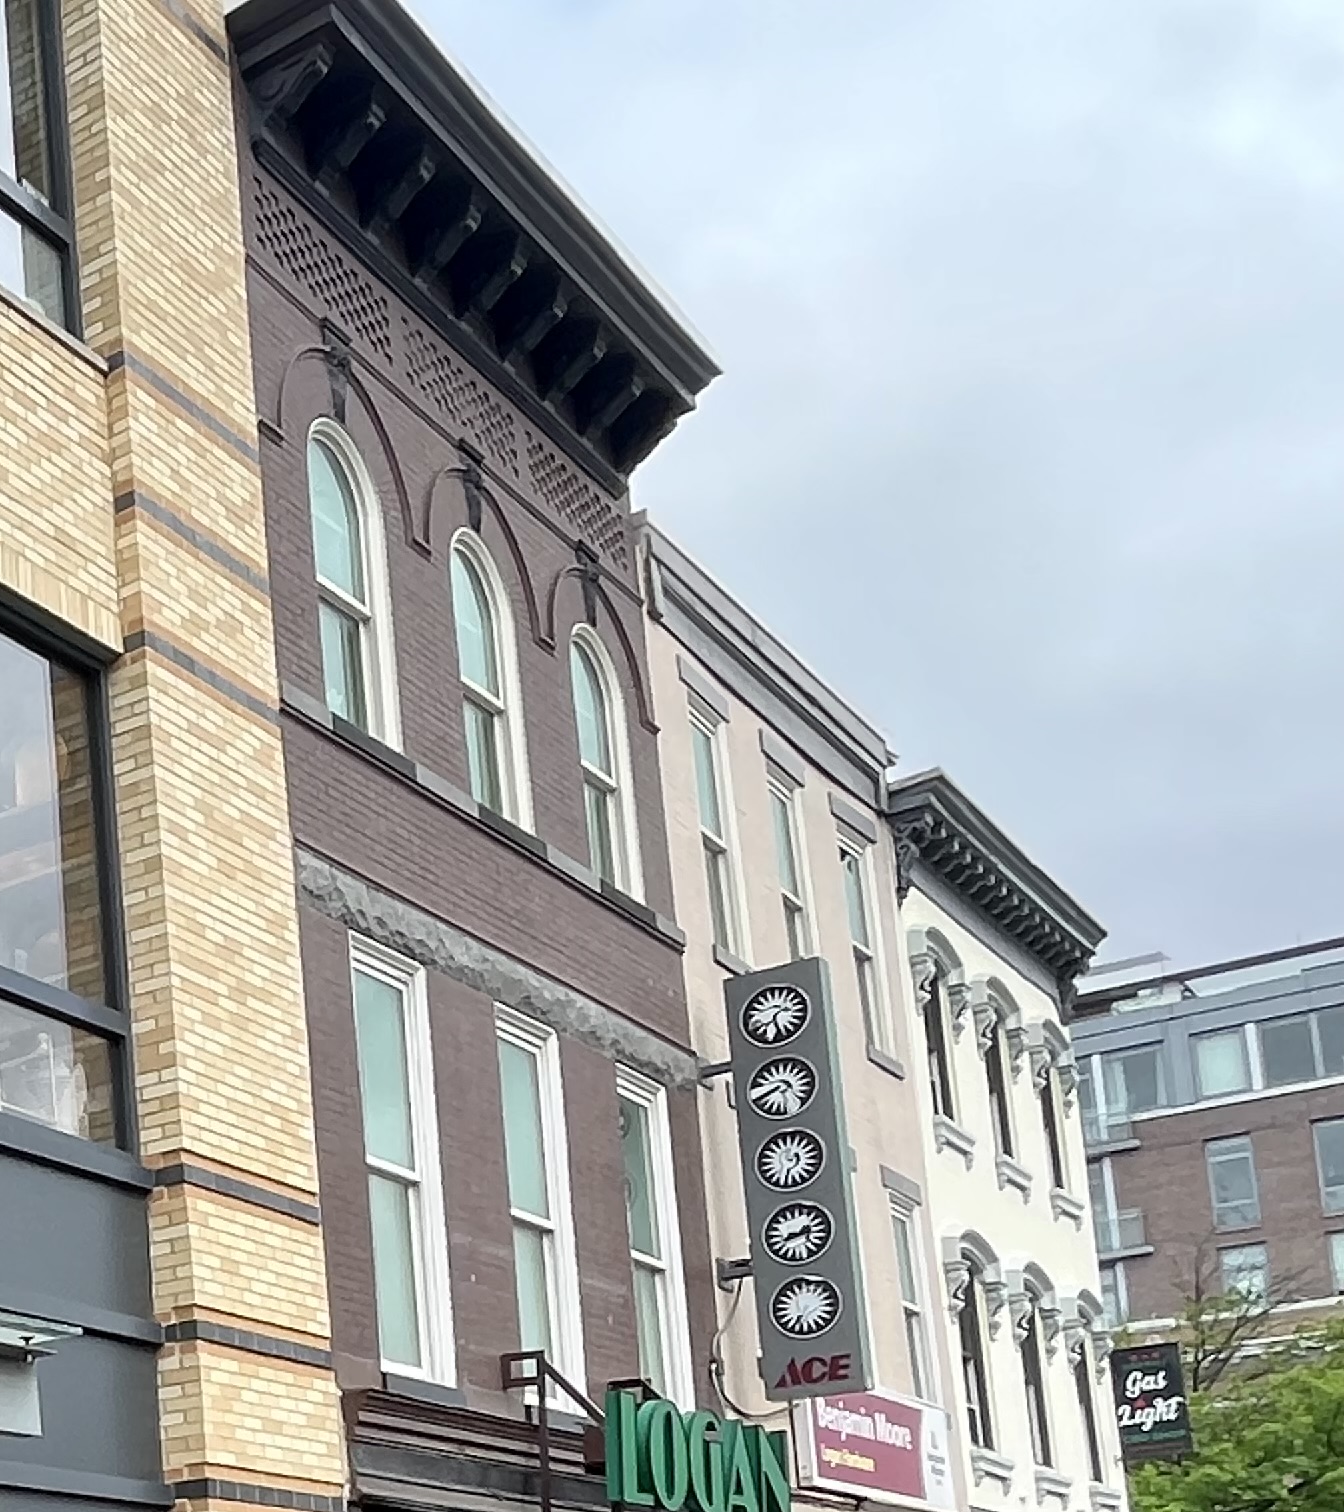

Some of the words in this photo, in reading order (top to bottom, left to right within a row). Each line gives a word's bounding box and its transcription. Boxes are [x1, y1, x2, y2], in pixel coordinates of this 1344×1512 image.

[774, 1353, 852, 1389] ACE
[1124, 1370, 1169, 1398] Gas
[1118, 1396, 1186, 1432] Light
